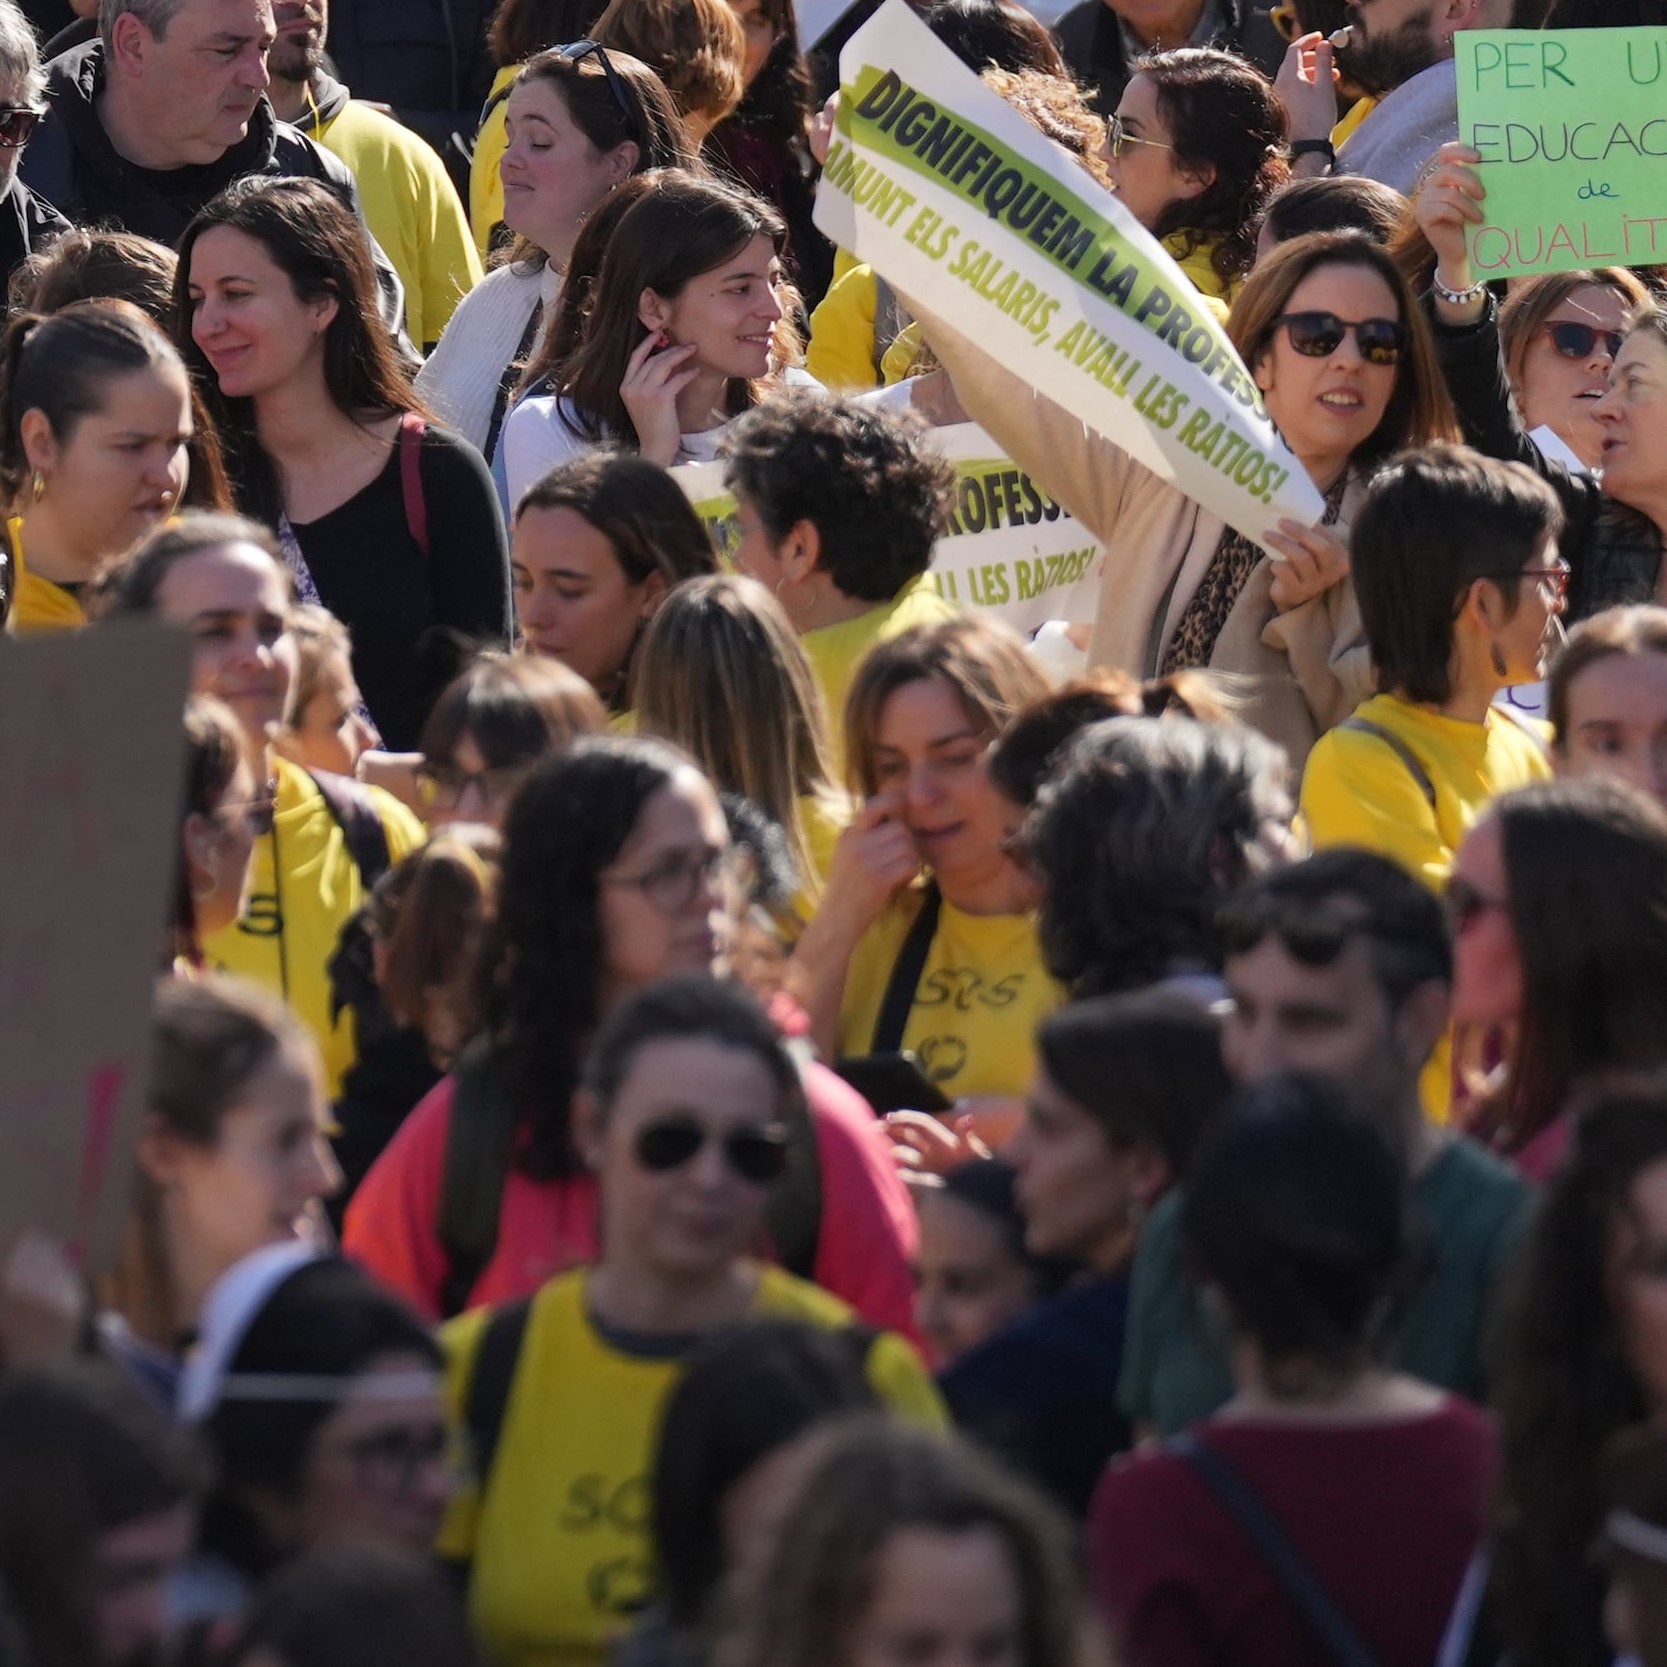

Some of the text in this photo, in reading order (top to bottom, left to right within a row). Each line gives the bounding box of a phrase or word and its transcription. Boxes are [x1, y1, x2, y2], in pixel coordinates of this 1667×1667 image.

[1473, 39, 1667, 92] PER U
[1577, 178, 1620, 201] de
[856, 67, 1276, 429] DIGNIFIQUEM LA PROFESS
[1472, 213, 1667, 271] QUALIT
[822, 139, 916, 229] AMUNT
[903, 205, 960, 263] ELS
[949, 239, 1061, 347] SALARIS,
[1055, 319, 1131, 399] AVALL
[1132, 374, 1189, 430] LES
[966, 561, 1011, 607] LES
